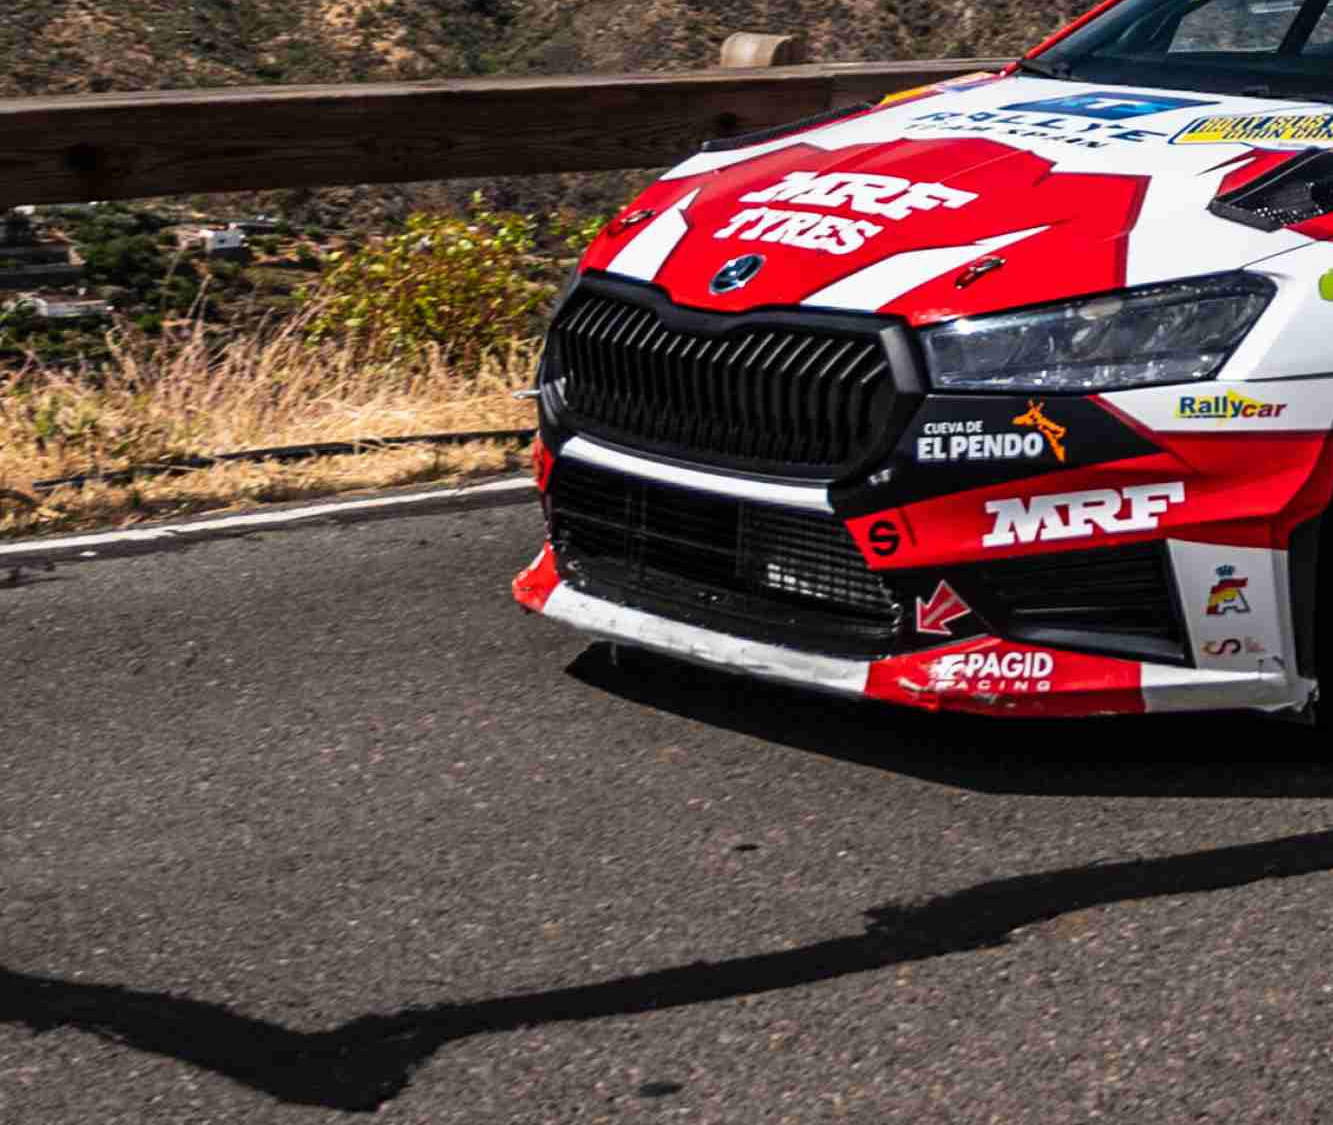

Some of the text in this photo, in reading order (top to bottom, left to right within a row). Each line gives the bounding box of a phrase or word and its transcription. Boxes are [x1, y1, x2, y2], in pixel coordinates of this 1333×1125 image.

[738, 171, 980, 220] MRF
[713, 206, 885, 255] TYRES
[1180, 396, 1288, 418] Rallycar
[923, 420, 983, 435] CUEVA DE
[917, 433, 1044, 462] EL PENDO
[982, 481, 1186, 548] MRF
[965, 651, 1054, 679] PAGID
